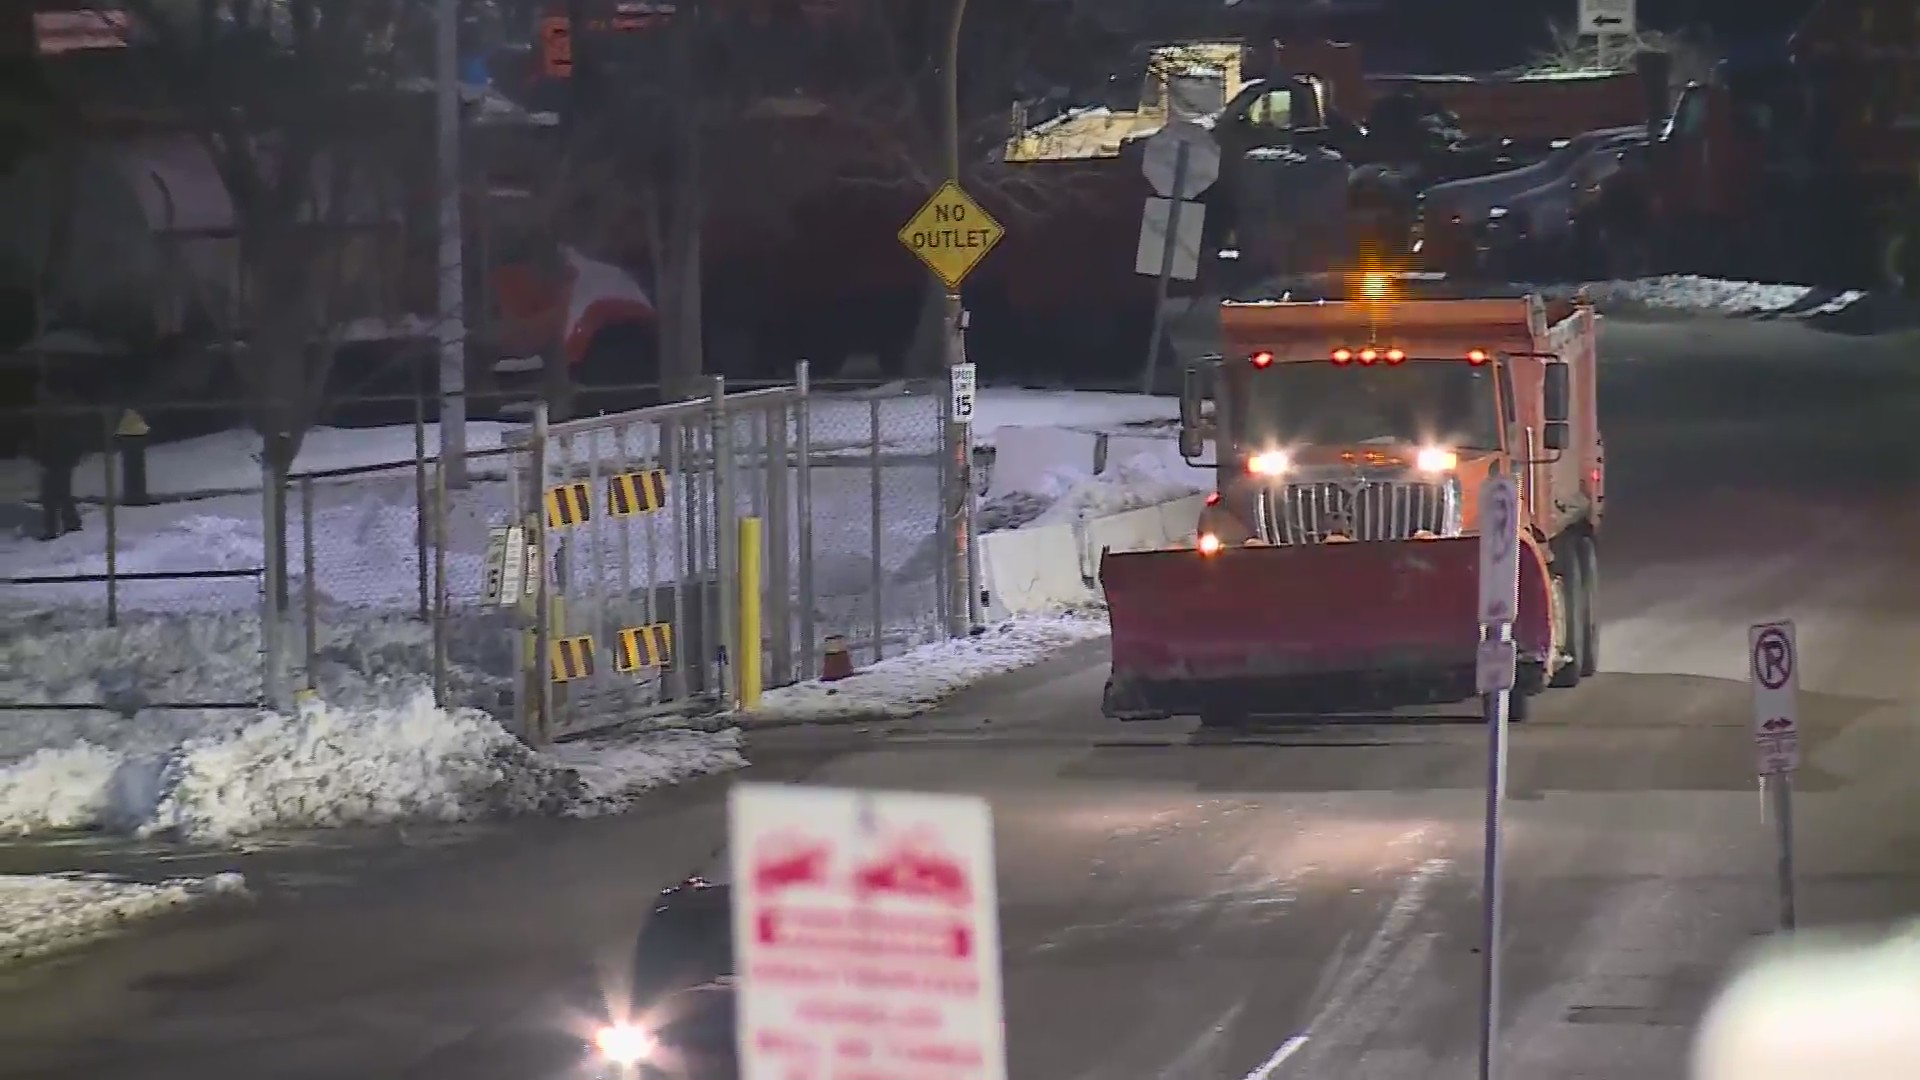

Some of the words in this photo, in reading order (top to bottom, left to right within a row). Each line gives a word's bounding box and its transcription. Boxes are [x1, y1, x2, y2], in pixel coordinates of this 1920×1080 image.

[935, 204, 966, 221] NO
[913, 228, 990, 248] OUTLET
[956, 394, 972, 416] 15
